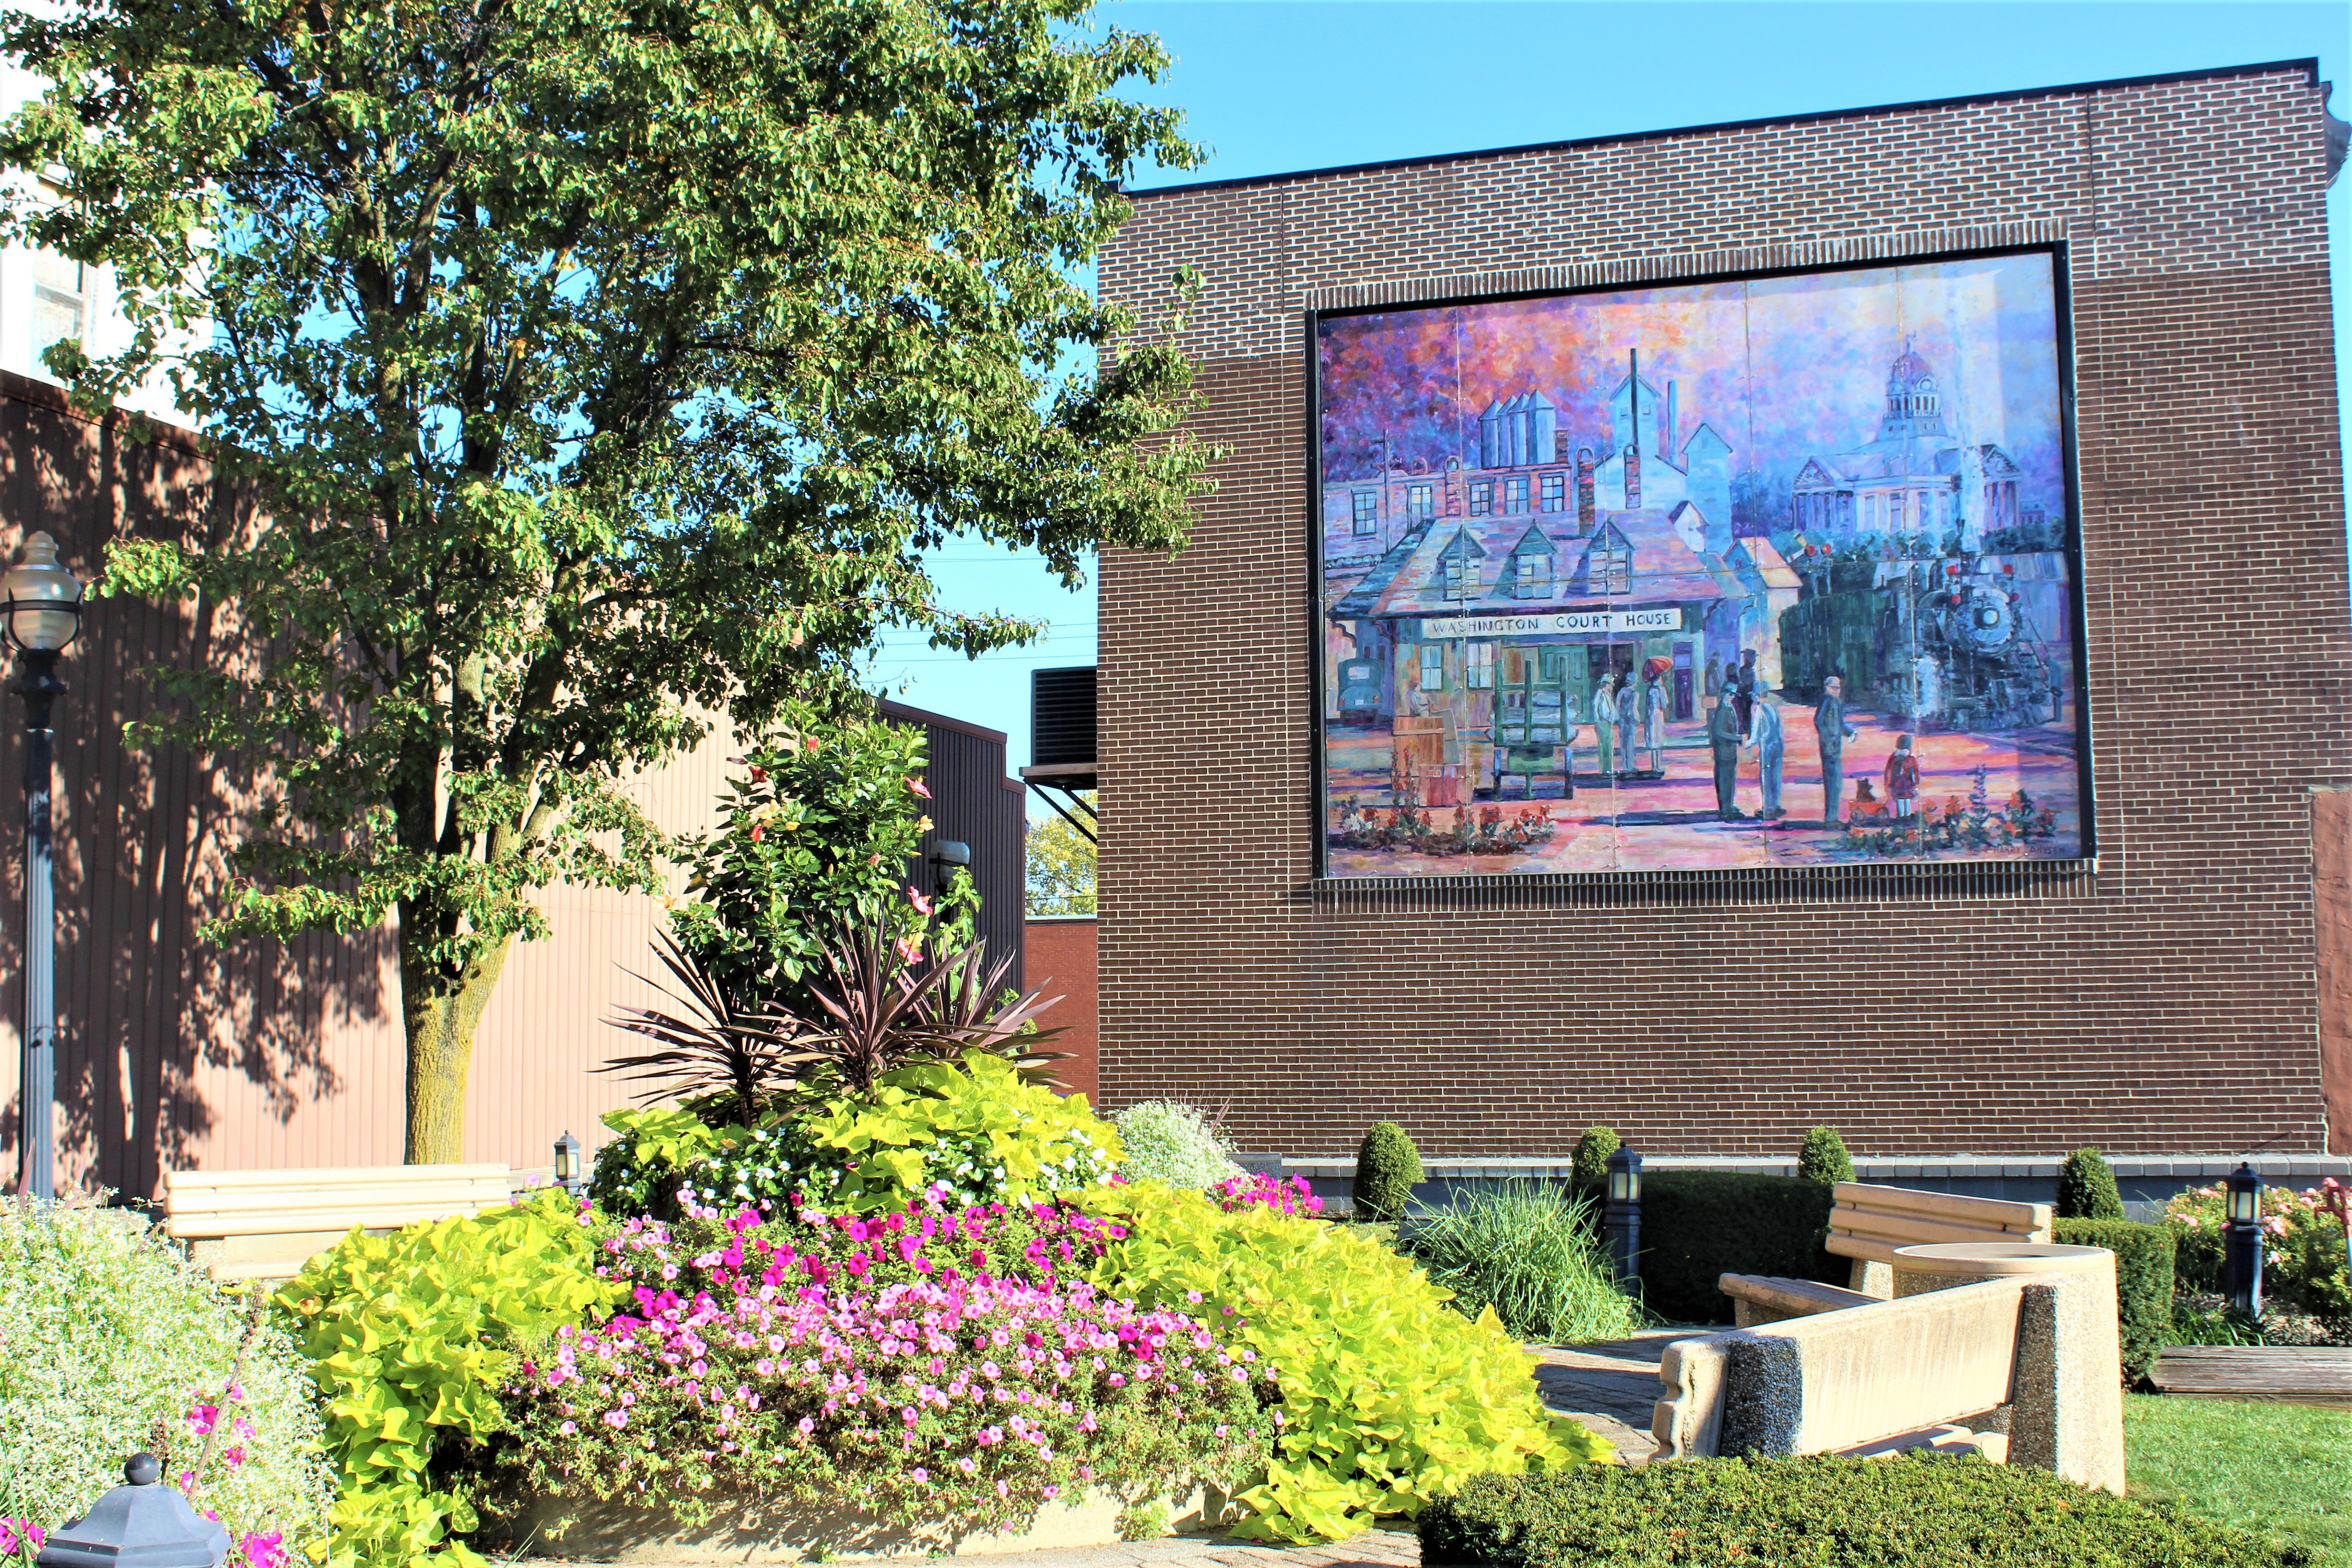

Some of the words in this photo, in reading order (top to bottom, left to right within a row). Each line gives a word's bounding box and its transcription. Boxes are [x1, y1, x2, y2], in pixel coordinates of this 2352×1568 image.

[1433, 619, 1539, 633] WASHINGTON
[1556, 615, 1612, 628] COURT
[1626, 613, 1671, 626] HOUSE
